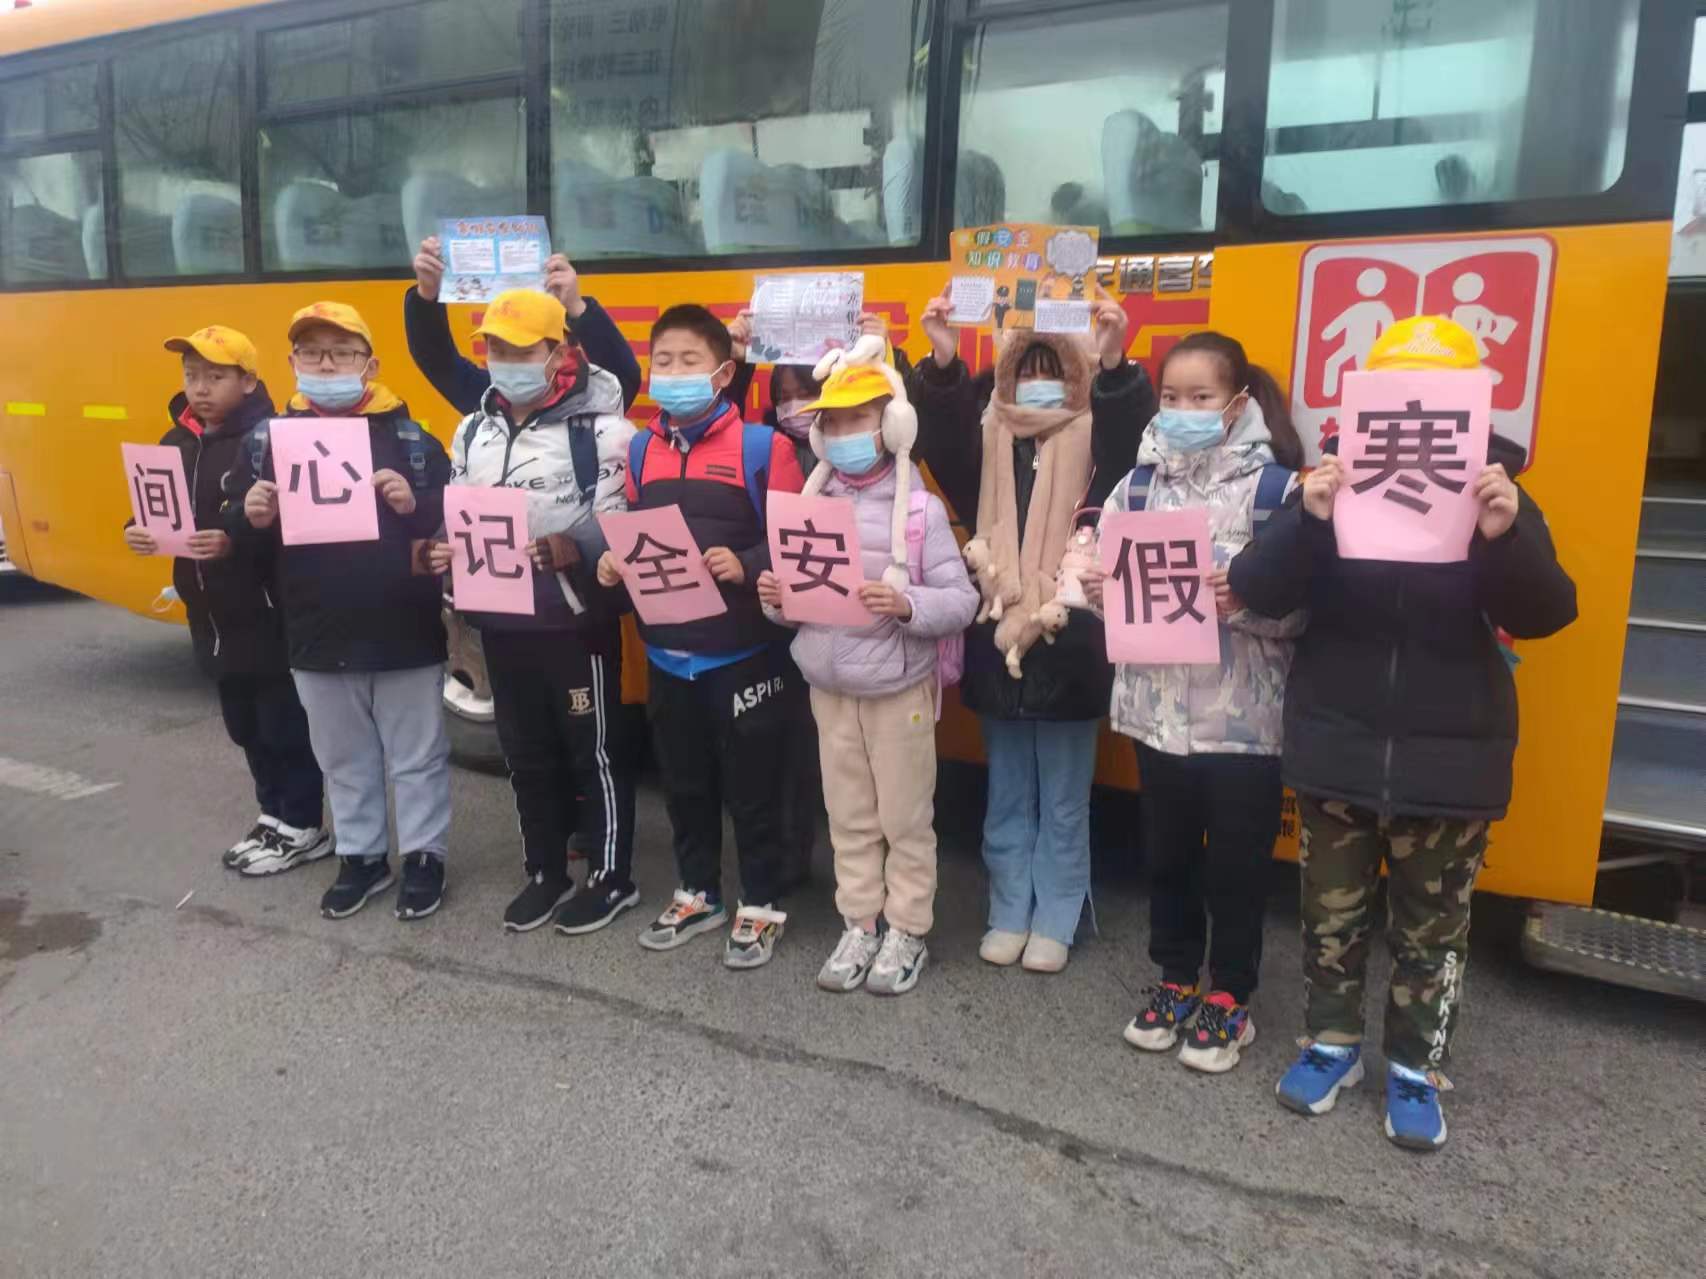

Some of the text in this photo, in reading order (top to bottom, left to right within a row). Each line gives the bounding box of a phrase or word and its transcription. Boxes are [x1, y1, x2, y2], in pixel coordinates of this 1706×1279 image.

[288, 439, 362, 506] 心
[1351, 400, 1471, 515] 寒
[134, 462, 183, 532] 间
[454, 509, 525, 579] 记
[624, 532, 700, 596] 全
[779, 519, 850, 597] 安
[1111, 536, 1207, 625] 假
